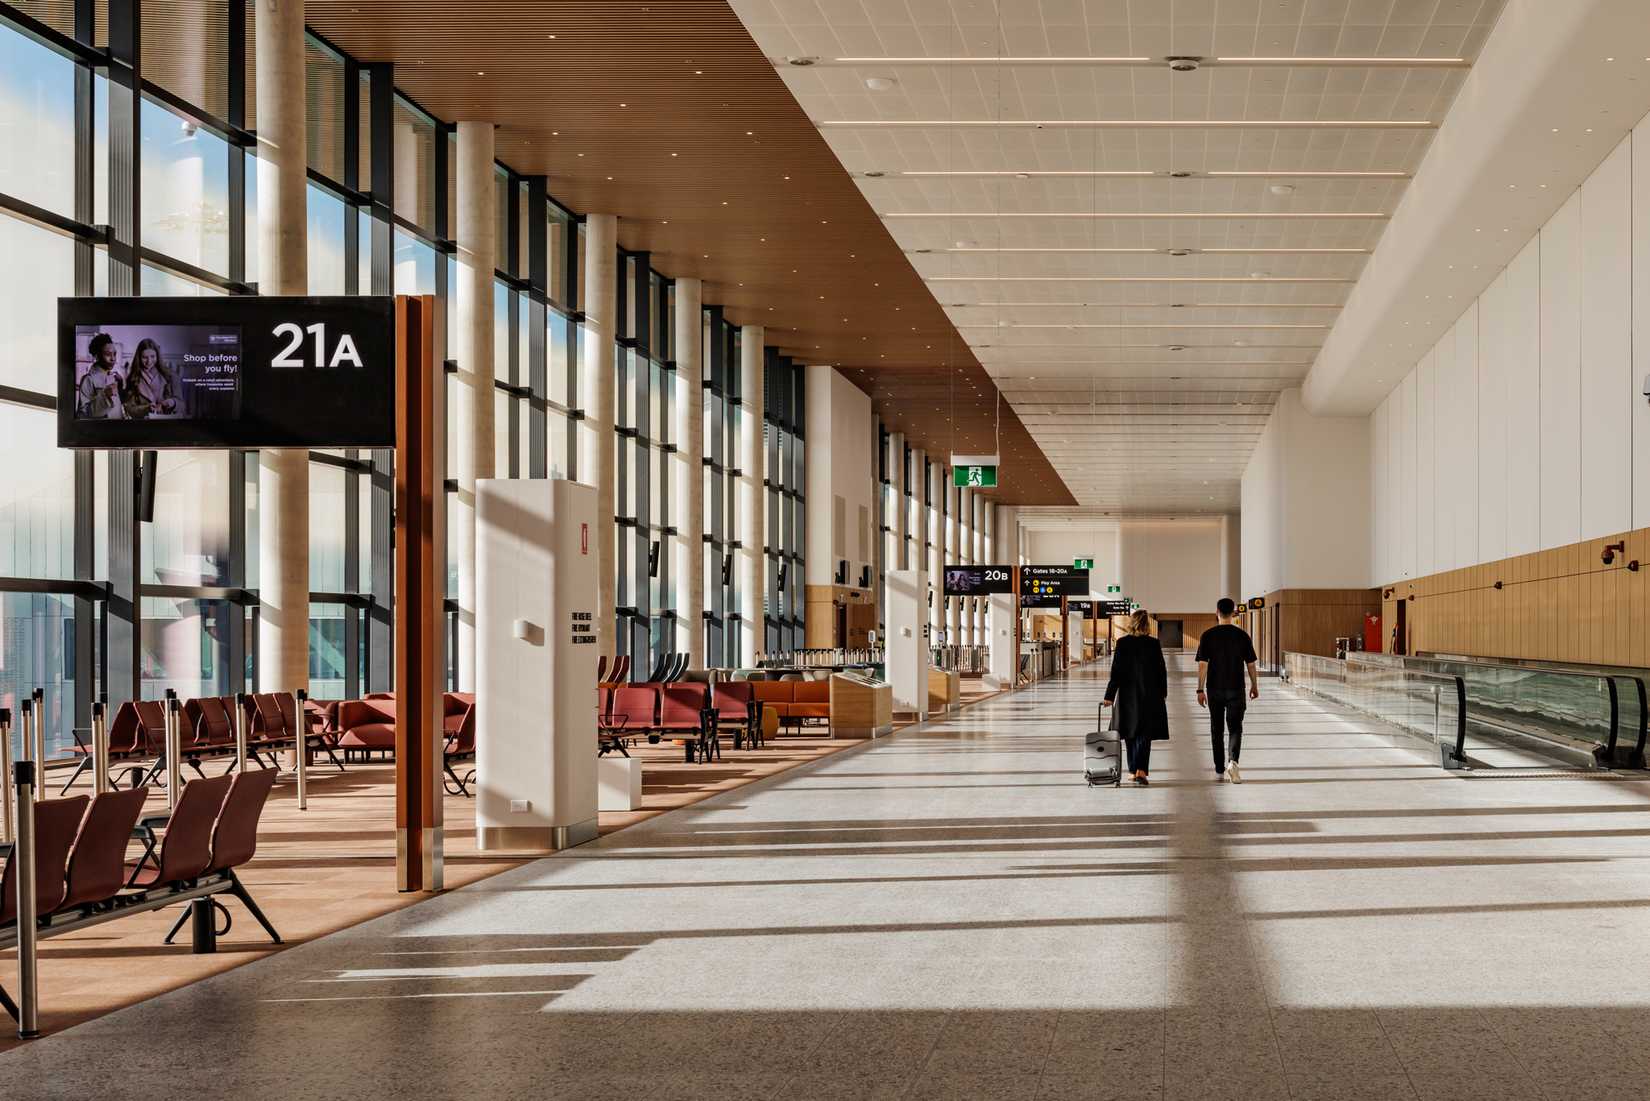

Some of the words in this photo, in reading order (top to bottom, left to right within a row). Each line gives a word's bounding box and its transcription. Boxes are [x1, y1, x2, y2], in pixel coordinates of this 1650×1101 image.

[271, 323, 364, 368] 21A
[183, 354, 207, 363] Shop
[208, 354, 238, 362] before
[205, 366, 221, 374] you
[223, 364, 238, 374] fly!
[984, 570, 1009, 581] 20B
